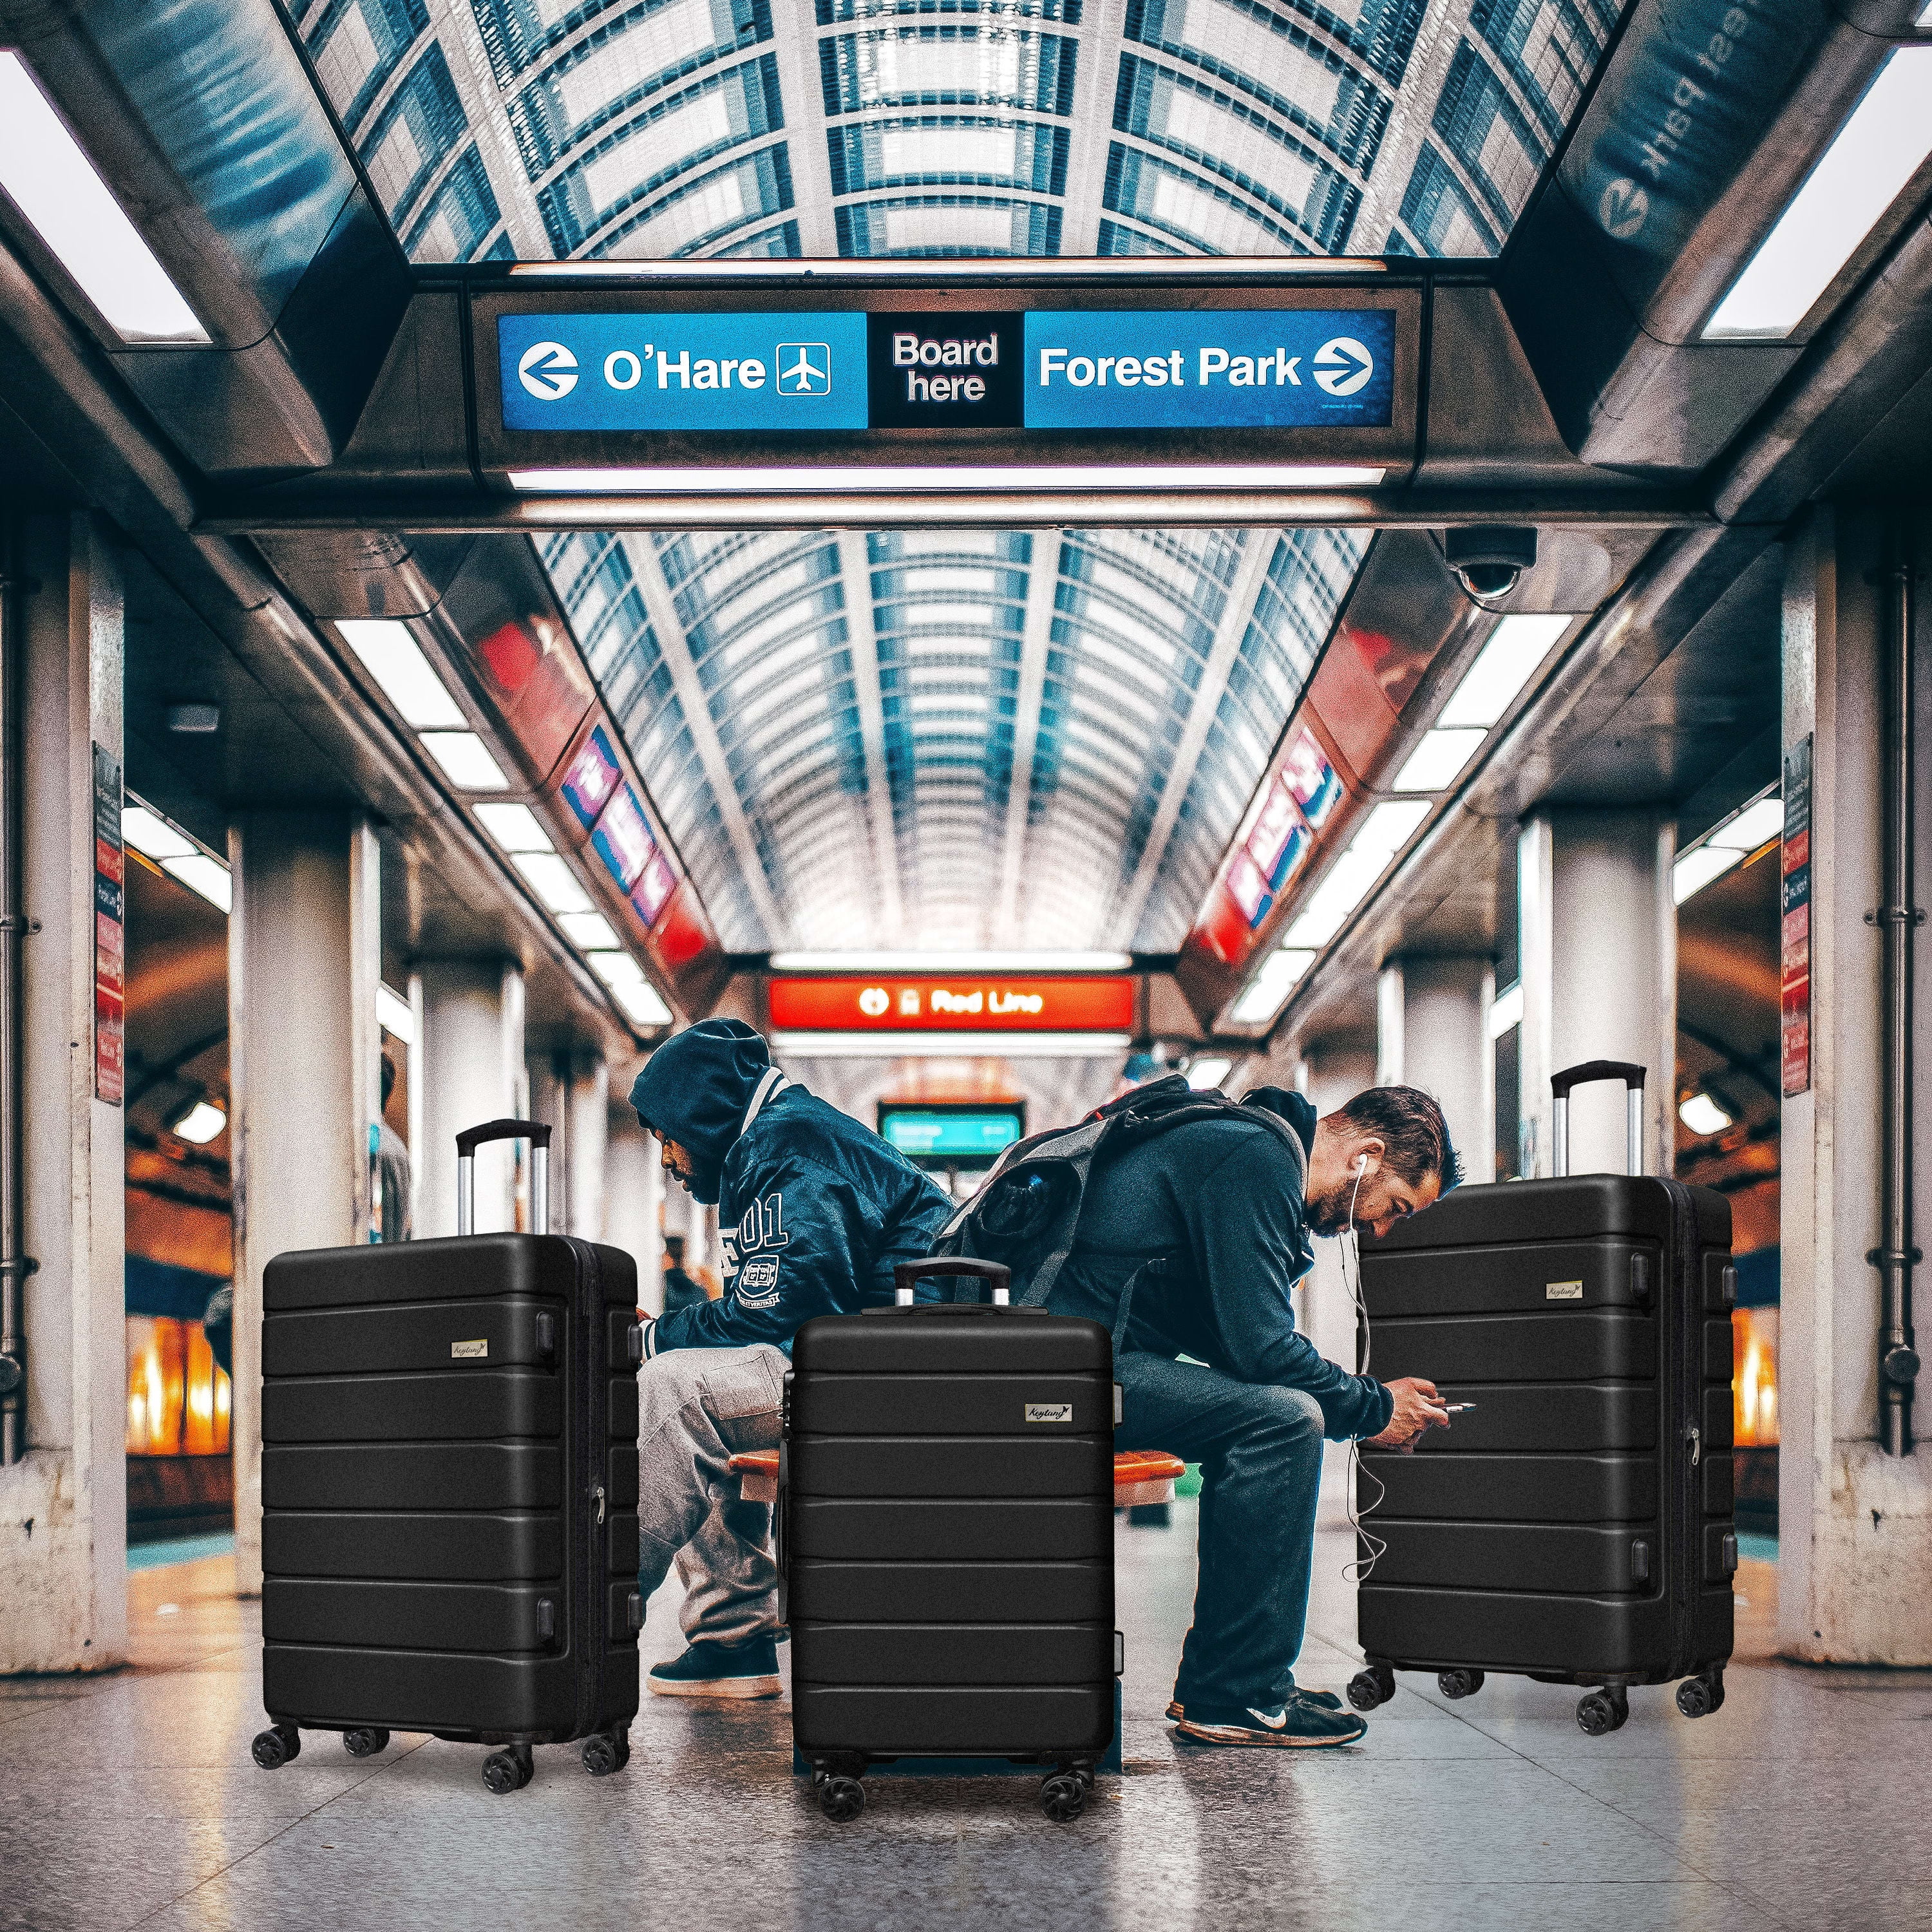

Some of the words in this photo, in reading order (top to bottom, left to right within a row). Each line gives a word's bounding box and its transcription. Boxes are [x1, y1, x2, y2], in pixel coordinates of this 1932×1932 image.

[603, 344, 766, 390] O'Hare
[893, 334, 999, 366] Board
[1039, 347, 1186, 388] Forest
[1198, 346, 1302, 388] Park
[907, 370, 986, 402] here
